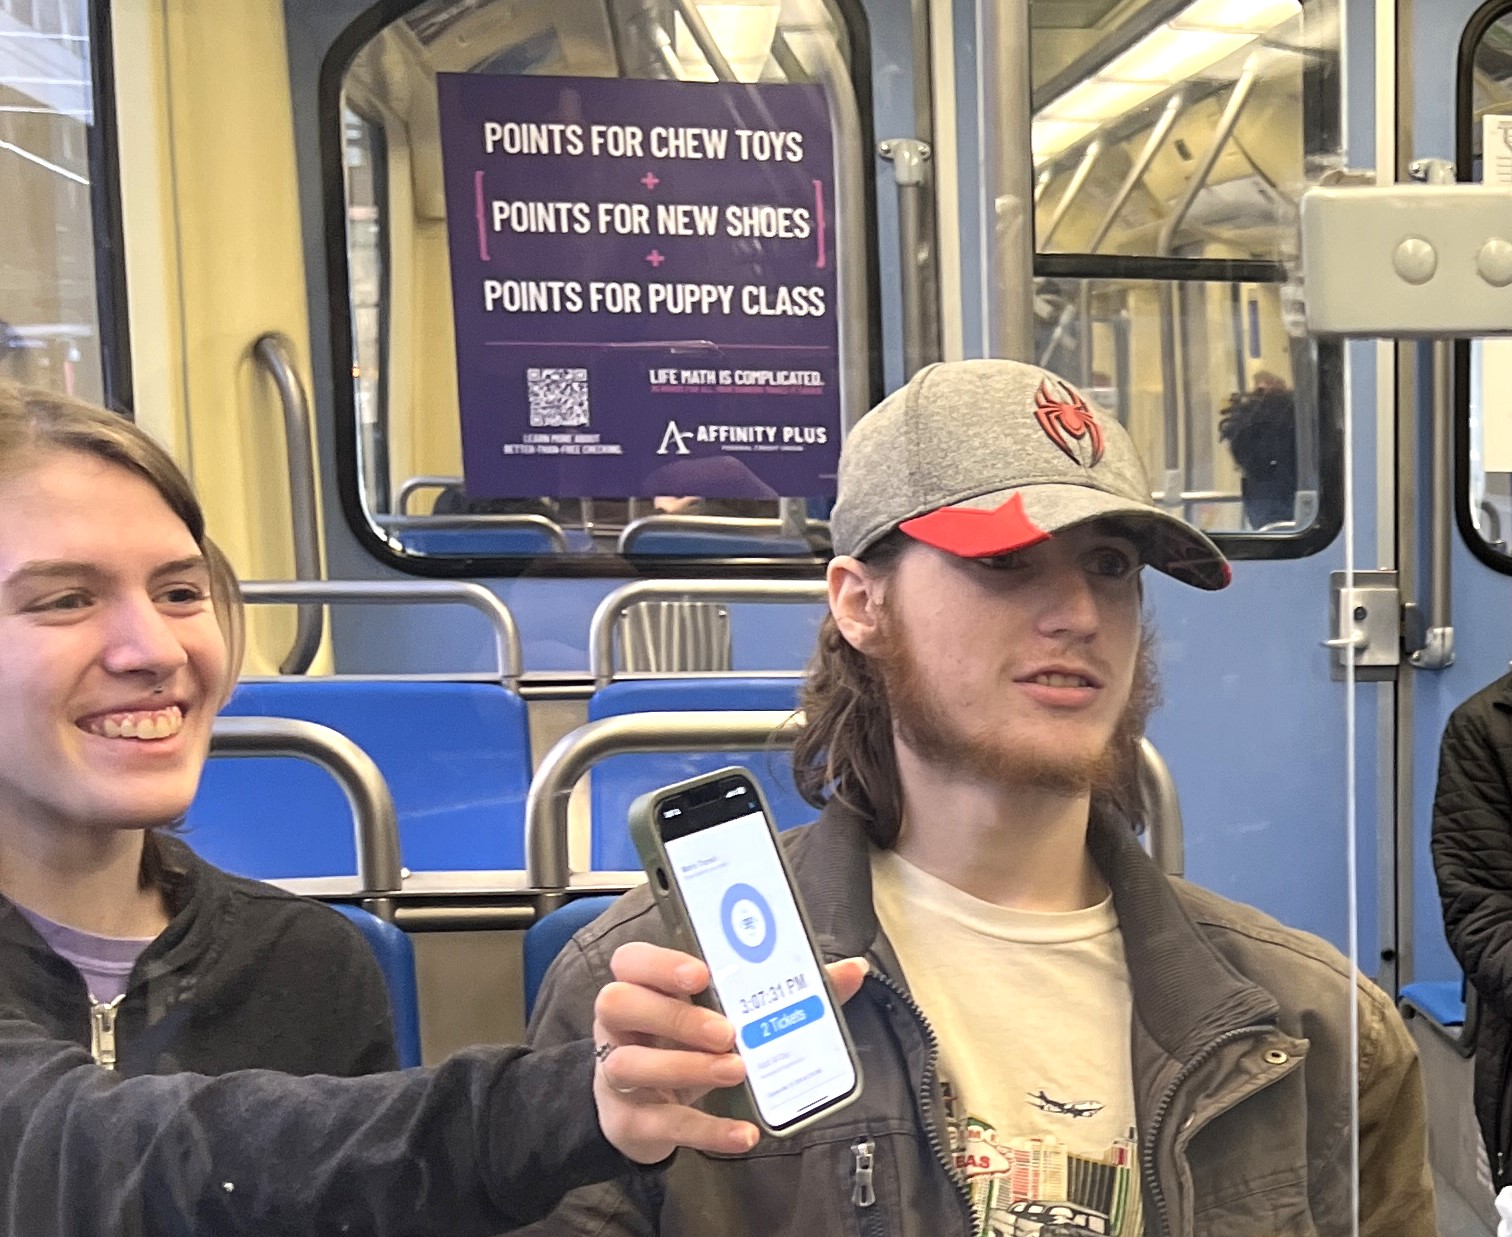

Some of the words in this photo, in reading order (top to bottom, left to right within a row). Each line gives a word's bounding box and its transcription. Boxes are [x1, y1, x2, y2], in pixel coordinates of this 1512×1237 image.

[484, 122, 583, 155] POINTS
[591, 125, 643, 157] FOR
[651, 127, 728, 159] CHEW
[735, 130, 804, 162] TOYS
[492, 201, 591, 234] POINTS
[598, 202, 650, 235] FOR
[657, 205, 718, 236] NEW
[726, 206, 811, 239] SHOES
[484, 280, 583, 313] POINTS
[589, 282, 642, 314] FOR
[648, 283, 735, 315] PUPPY
[742, 286, 826, 317] CLASS
[650, 368, 678, 385] LIFE
[681, 369, 717, 385] MATH
[719, 370, 732, 386] IS
[734, 370, 826, 386] COMPLICATED.
[697, 425, 777, 443] AFFINITY
[783, 426, 828, 444] PLUS
[786, 973, 808, 995] PM
[760, 1021, 772, 1038] 2
[769, 1009, 807, 1032] Tickets
